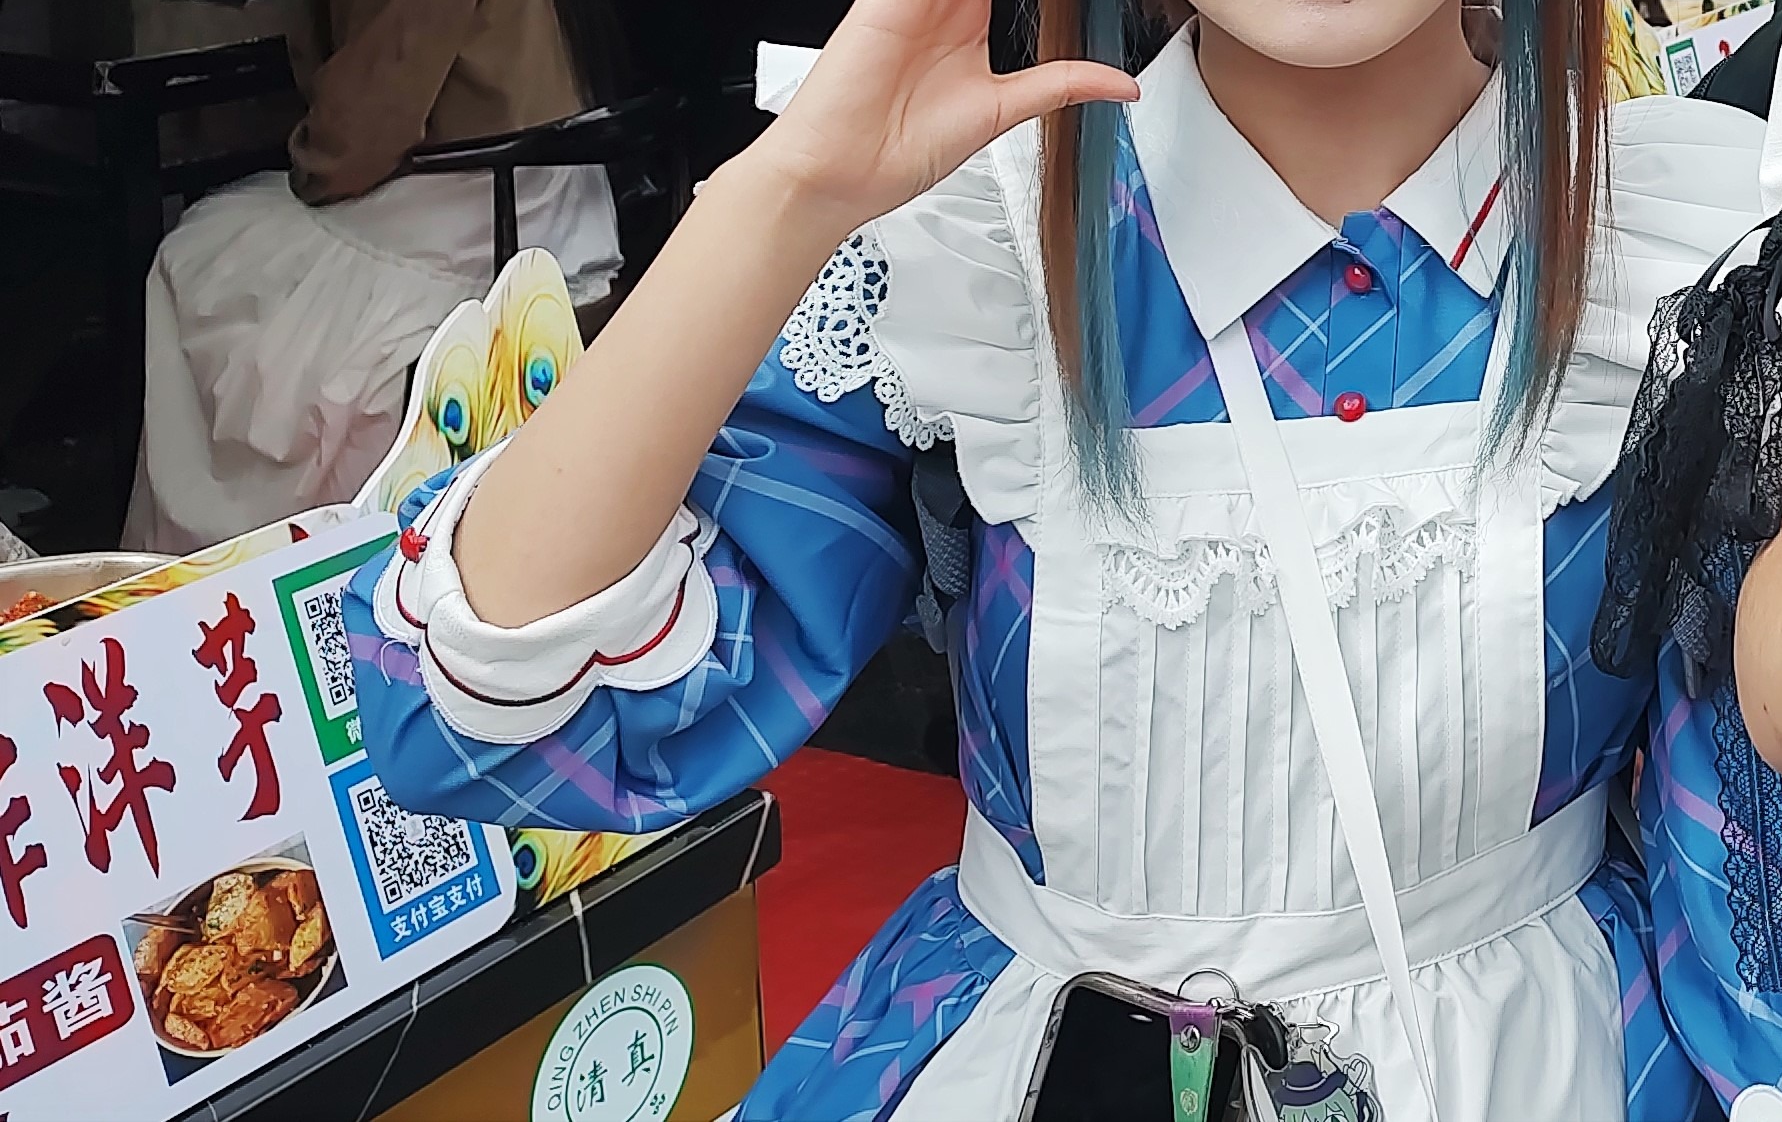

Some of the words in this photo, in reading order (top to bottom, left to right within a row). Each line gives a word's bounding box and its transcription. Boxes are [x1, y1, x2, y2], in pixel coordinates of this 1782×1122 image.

[389, 873, 484, 943] 支付宝支付
[547, 1045, 574, 1111] QING
[573, 987, 626, 1040] ZHEN
[630, 983, 662, 1007] SHI
[657, 997, 680, 1037] PIN
[576, 1029, 655, 1113] 清真
